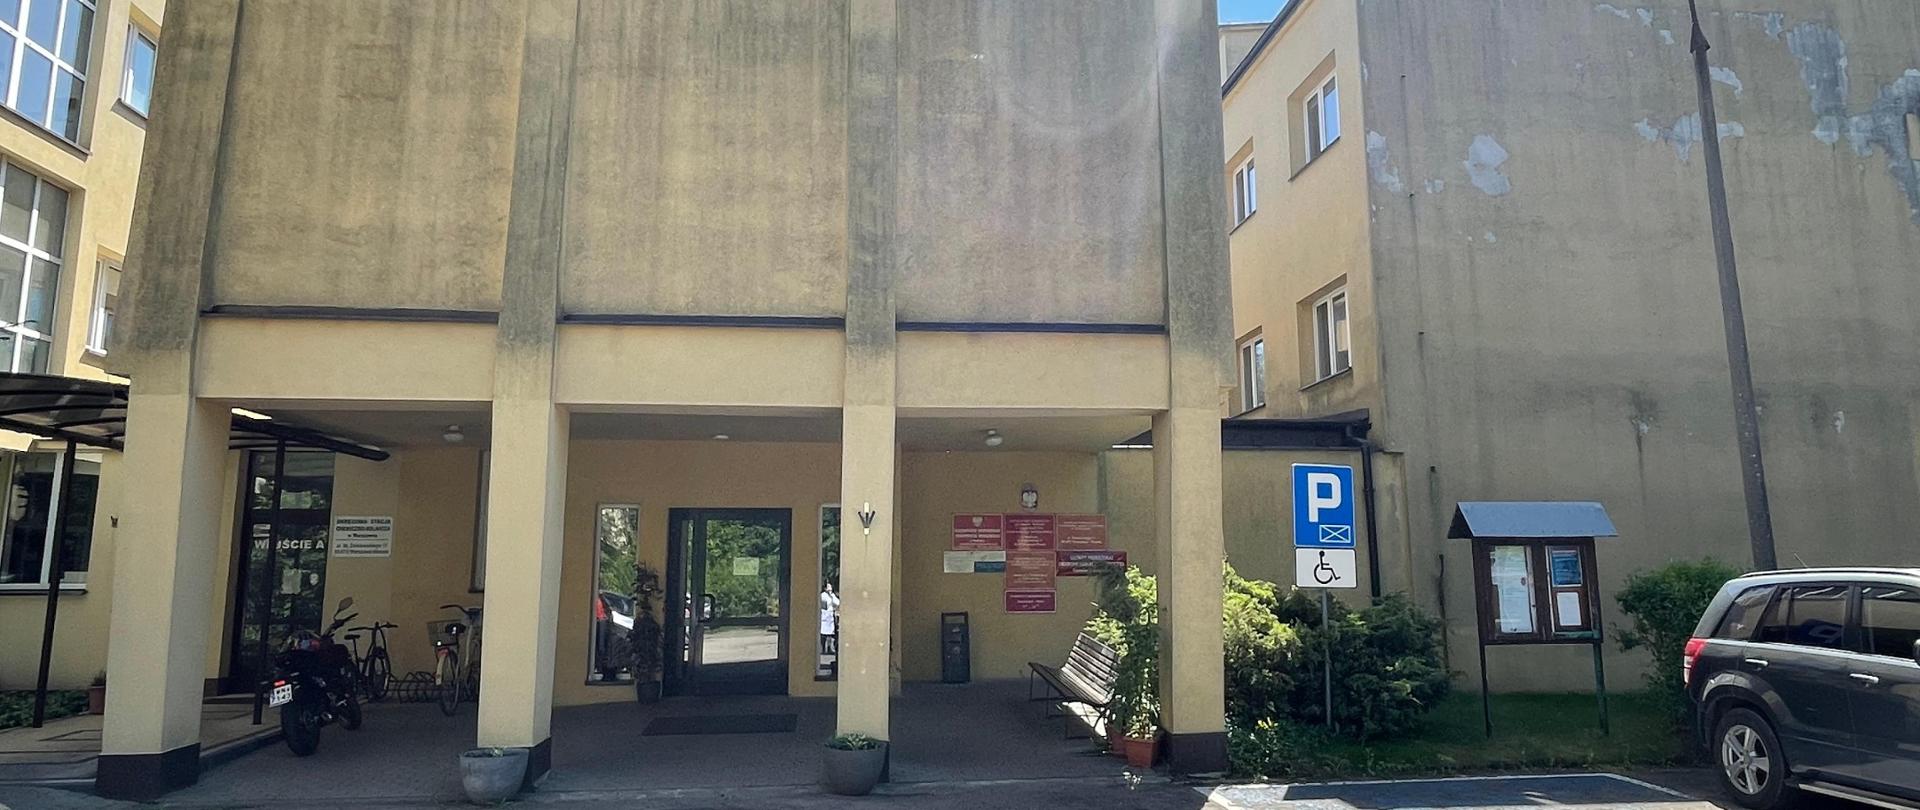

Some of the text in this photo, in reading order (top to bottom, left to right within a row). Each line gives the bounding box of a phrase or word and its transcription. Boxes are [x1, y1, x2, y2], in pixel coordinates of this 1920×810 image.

[1307, 472, 1341, 522] P
[254, 538, 312, 550] WJŚCIE
[315, 540, 325, 549] A
